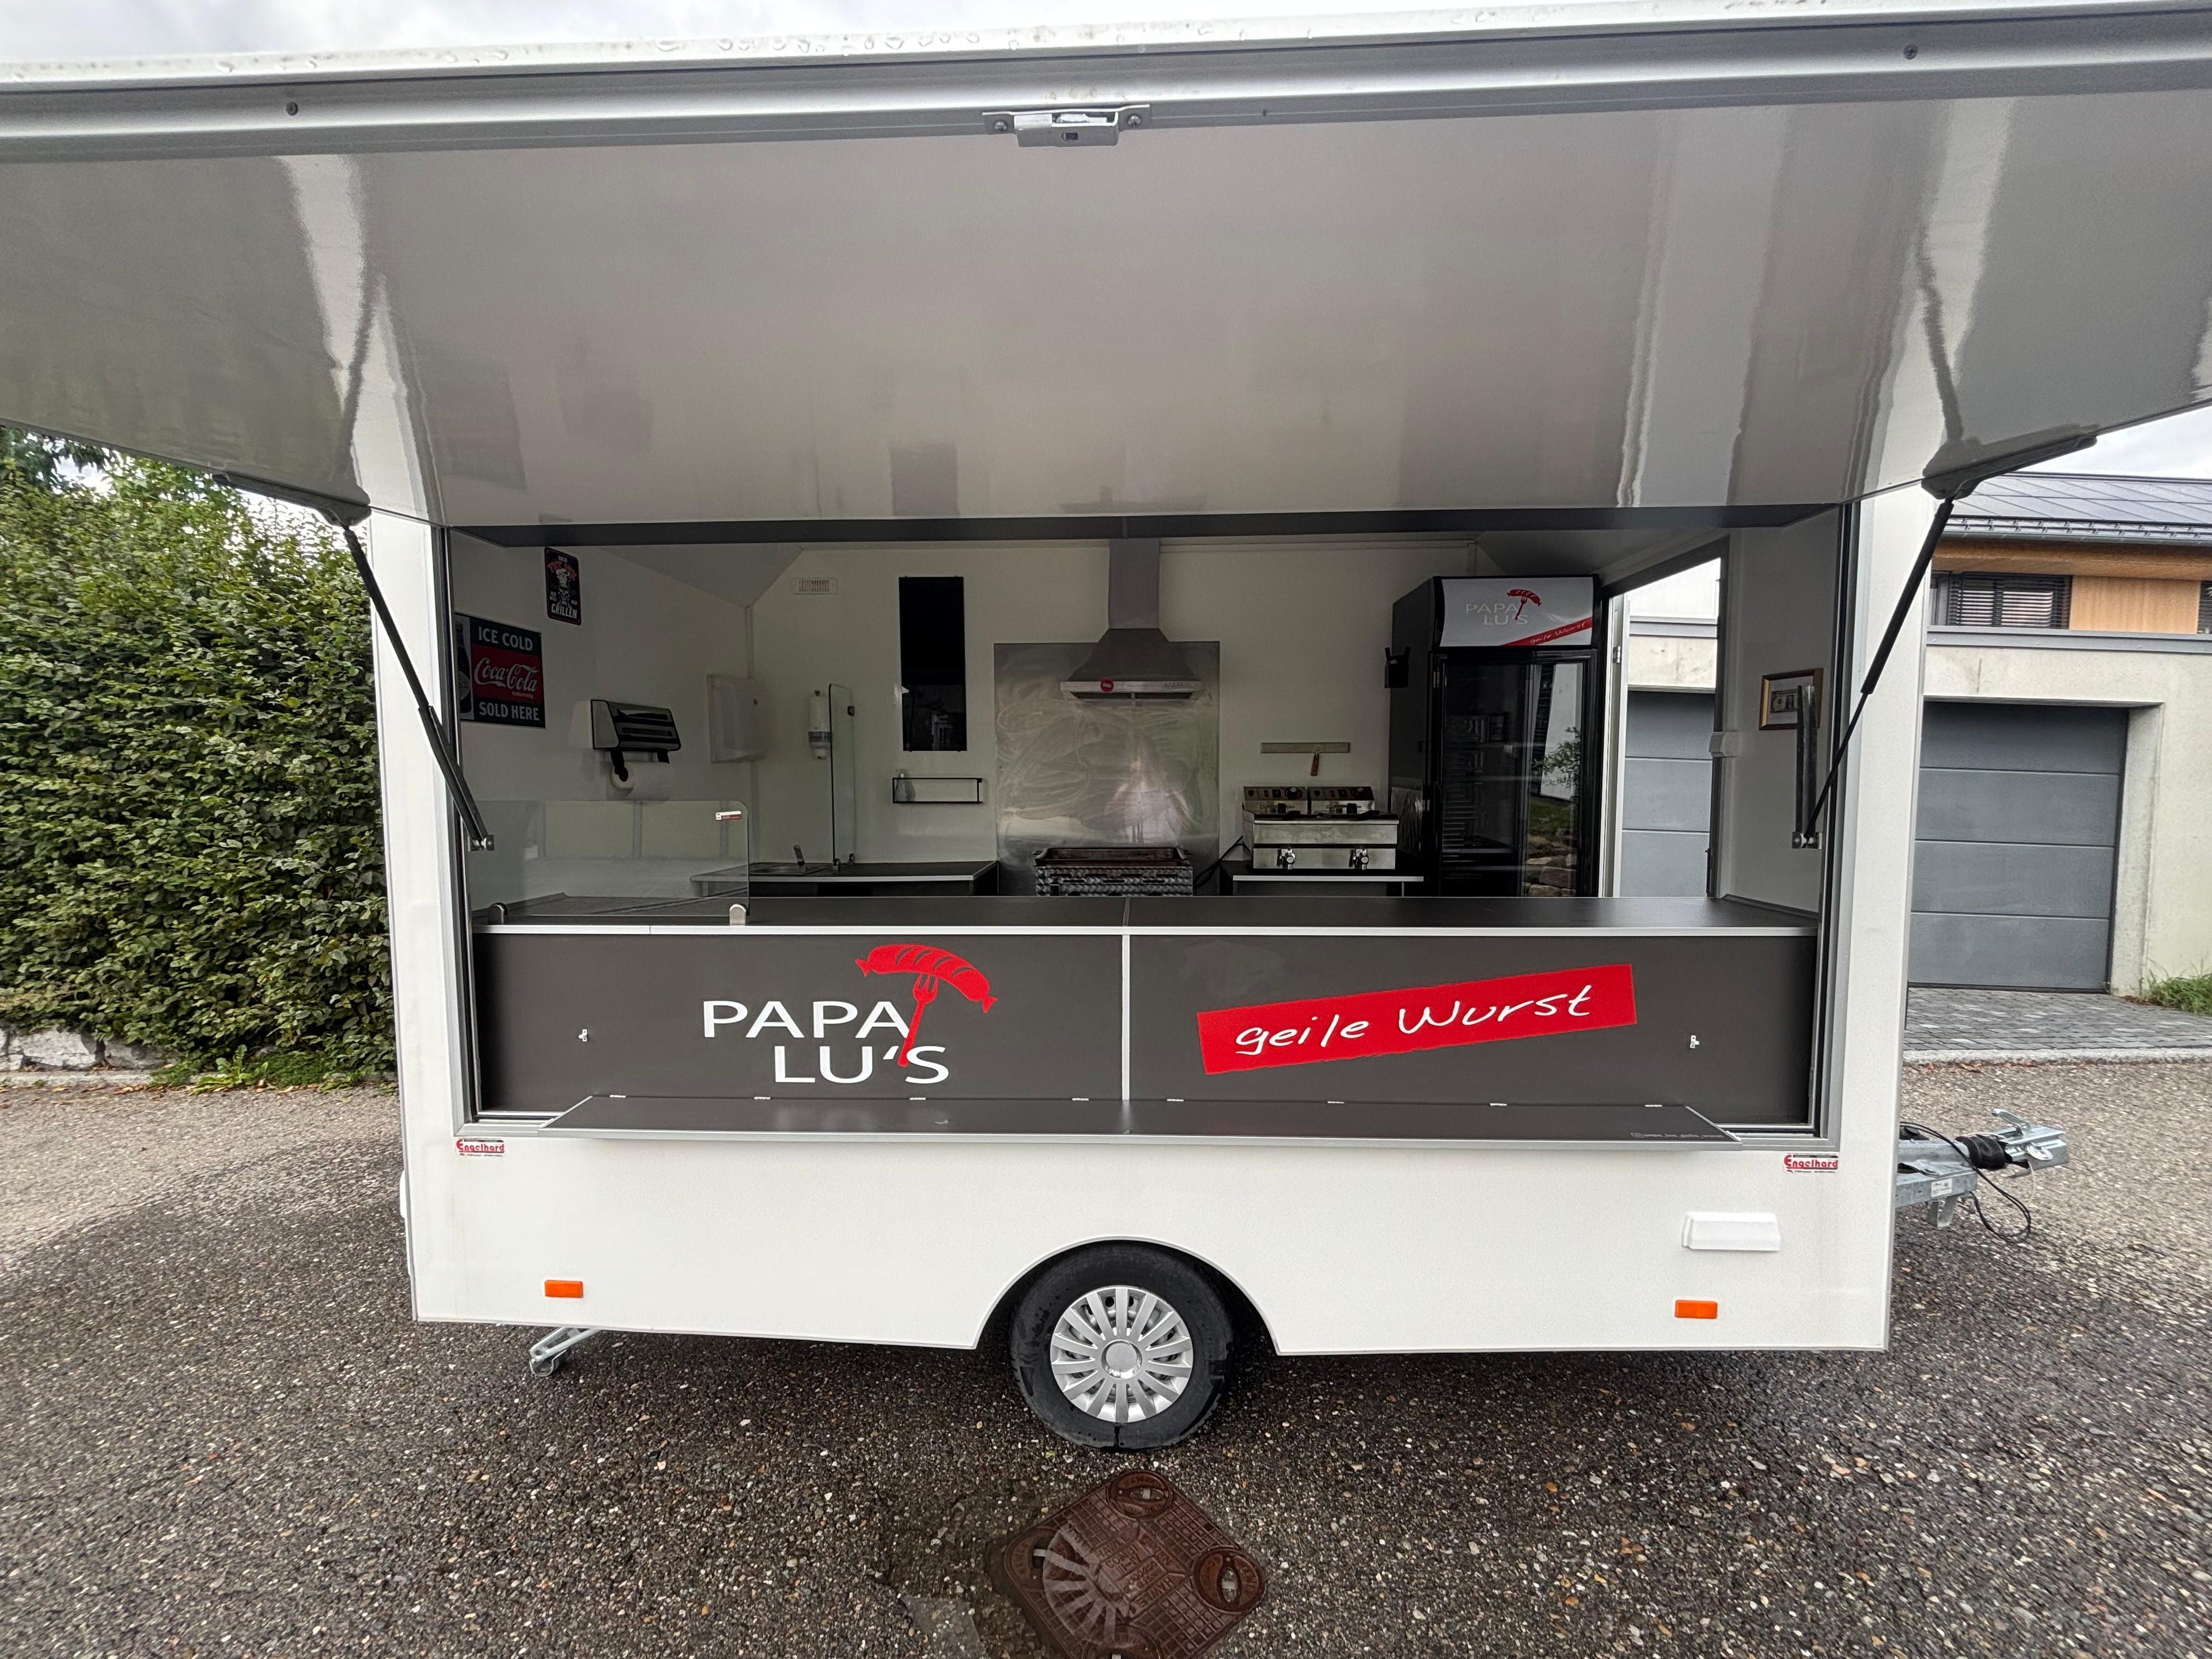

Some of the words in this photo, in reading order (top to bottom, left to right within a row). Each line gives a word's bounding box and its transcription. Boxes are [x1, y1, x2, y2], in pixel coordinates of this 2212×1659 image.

[551, 603, 578, 619] GRILLEN
[1466, 604, 1519, 614] PAPA
[478, 626, 499, 644] ICE
[502, 632, 533, 651] COLD
[479, 701, 509, 718] SOLD
[511, 705, 539, 721] HERE
[703, 1000, 910, 1039] PAPA
[1234, 1014, 1369, 1056] geile
[1397, 984, 1593, 1035] Wurst
[456, 1139, 505, 1152] Engelhard
[1783, 1154, 1838, 1168] Engelhard
